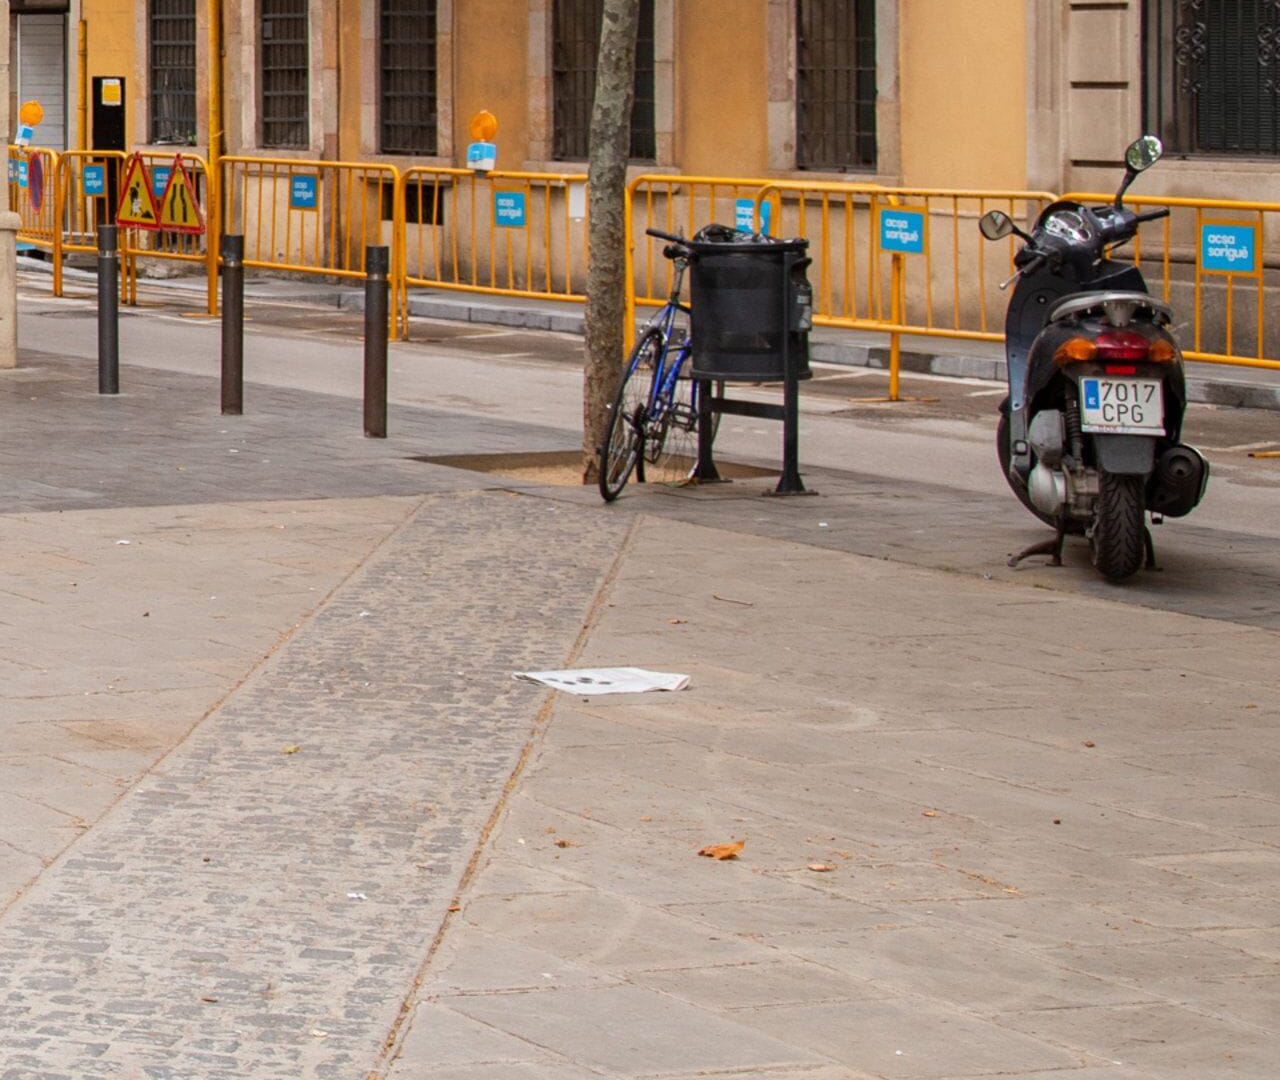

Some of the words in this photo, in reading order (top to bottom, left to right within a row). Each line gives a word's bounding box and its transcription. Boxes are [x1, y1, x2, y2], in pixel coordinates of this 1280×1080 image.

[1207, 234, 1236, 245] acsa
[1101, 382, 1156, 404] 7017
[1102, 403, 1144, 424] CPG
